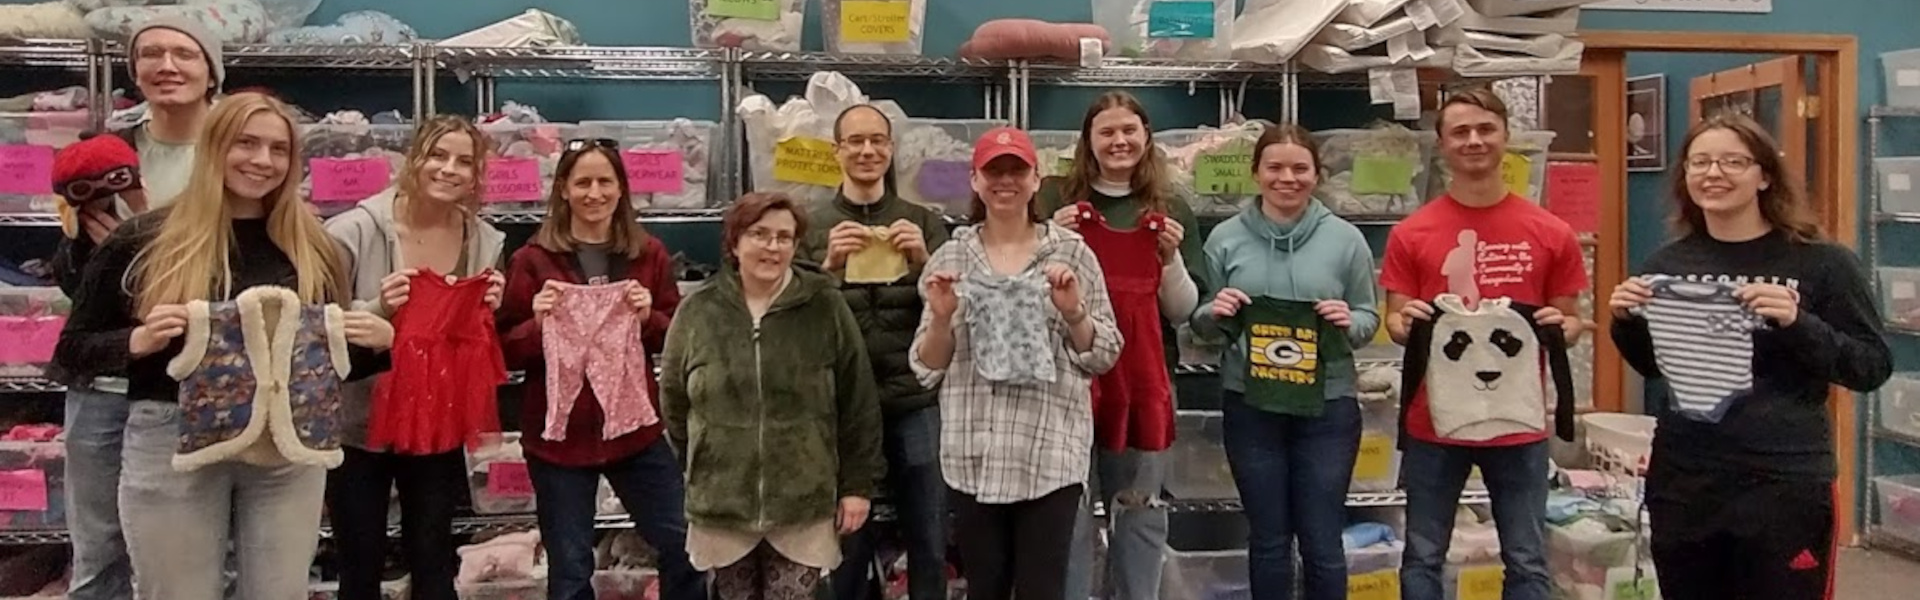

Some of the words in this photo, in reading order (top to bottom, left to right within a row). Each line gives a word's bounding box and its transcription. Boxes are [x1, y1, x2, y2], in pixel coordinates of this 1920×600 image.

[848, 14, 906, 23] Cart/Stroller
[861, 25, 895, 34] COVERS
[333, 163, 366, 174] GIRLS
[776, 158, 841, 174] PROTECTORS
[488, 169, 518, 180] GIRLS
[1213, 167, 1242, 177] SMALL
[1251, 324, 1293, 337] GREEN
[1250, 364, 1316, 385] PACKERS
